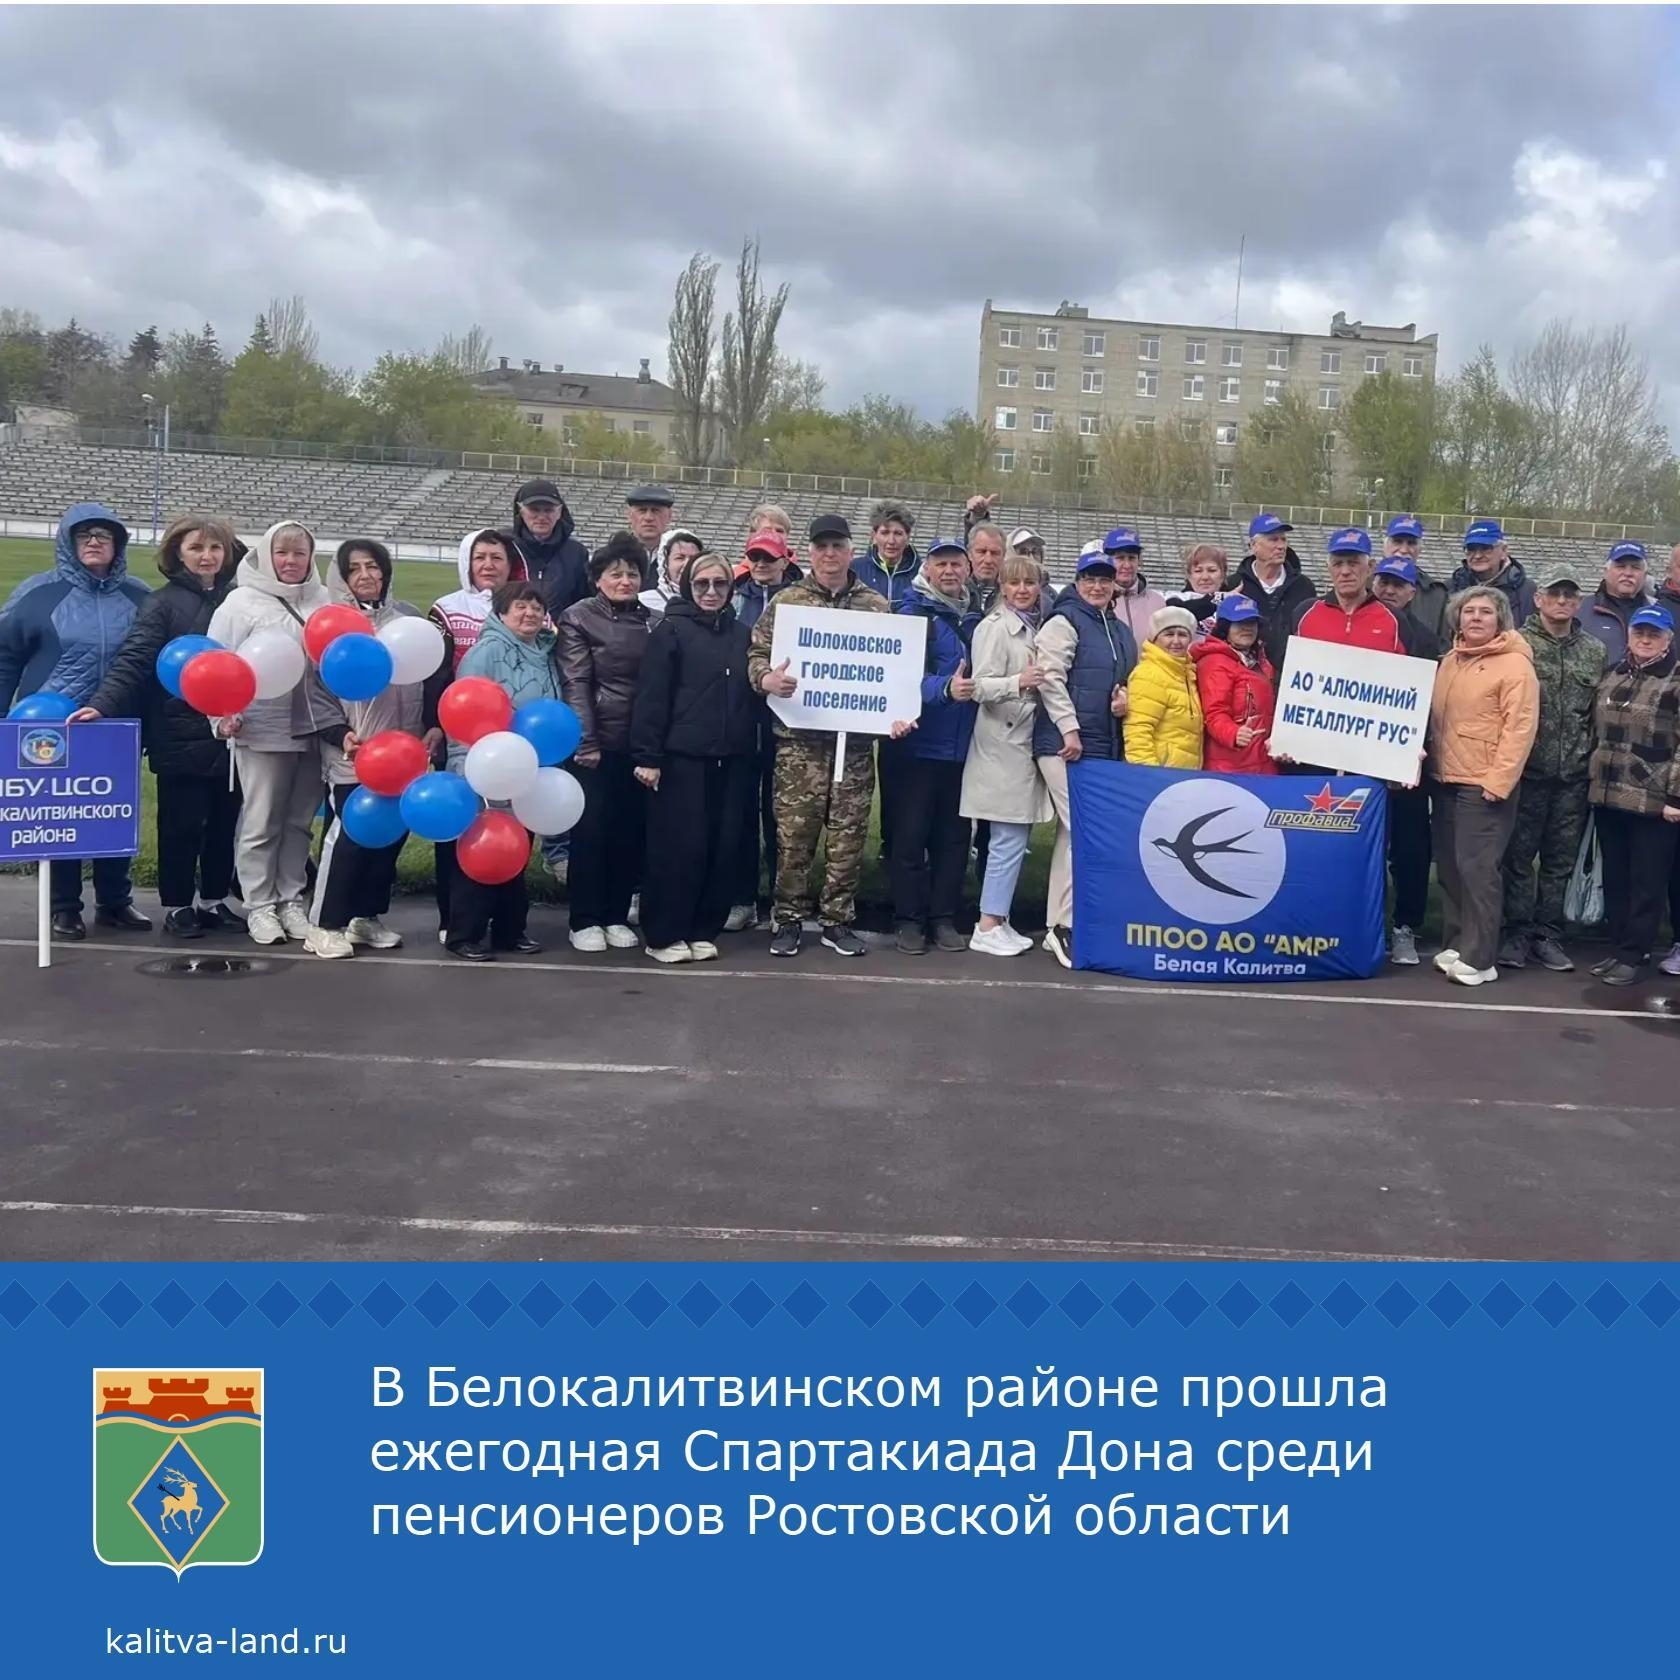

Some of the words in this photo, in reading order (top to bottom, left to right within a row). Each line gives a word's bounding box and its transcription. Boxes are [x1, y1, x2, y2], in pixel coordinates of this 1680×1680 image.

[798, 627, 902, 655] Шолоховское
[803, 690, 887, 713] поселение
[1290, 670, 1314, 691] АО
[1318, 674, 1417, 711] "АЛЮМИНИЙ
[1282, 703, 1374, 738] МЕТАЛЛУРГ
[1377, 721, 1417, 746] РУС"
[51, 776, 113, 796] ЦСО
[11, 825, 76, 849] района
[1126, 923, 1208, 950] ППОО
[1215, 930, 1256, 954] АО
[1153, 953, 1217, 974] Белая
[1223, 957, 1306, 975] Калитва
